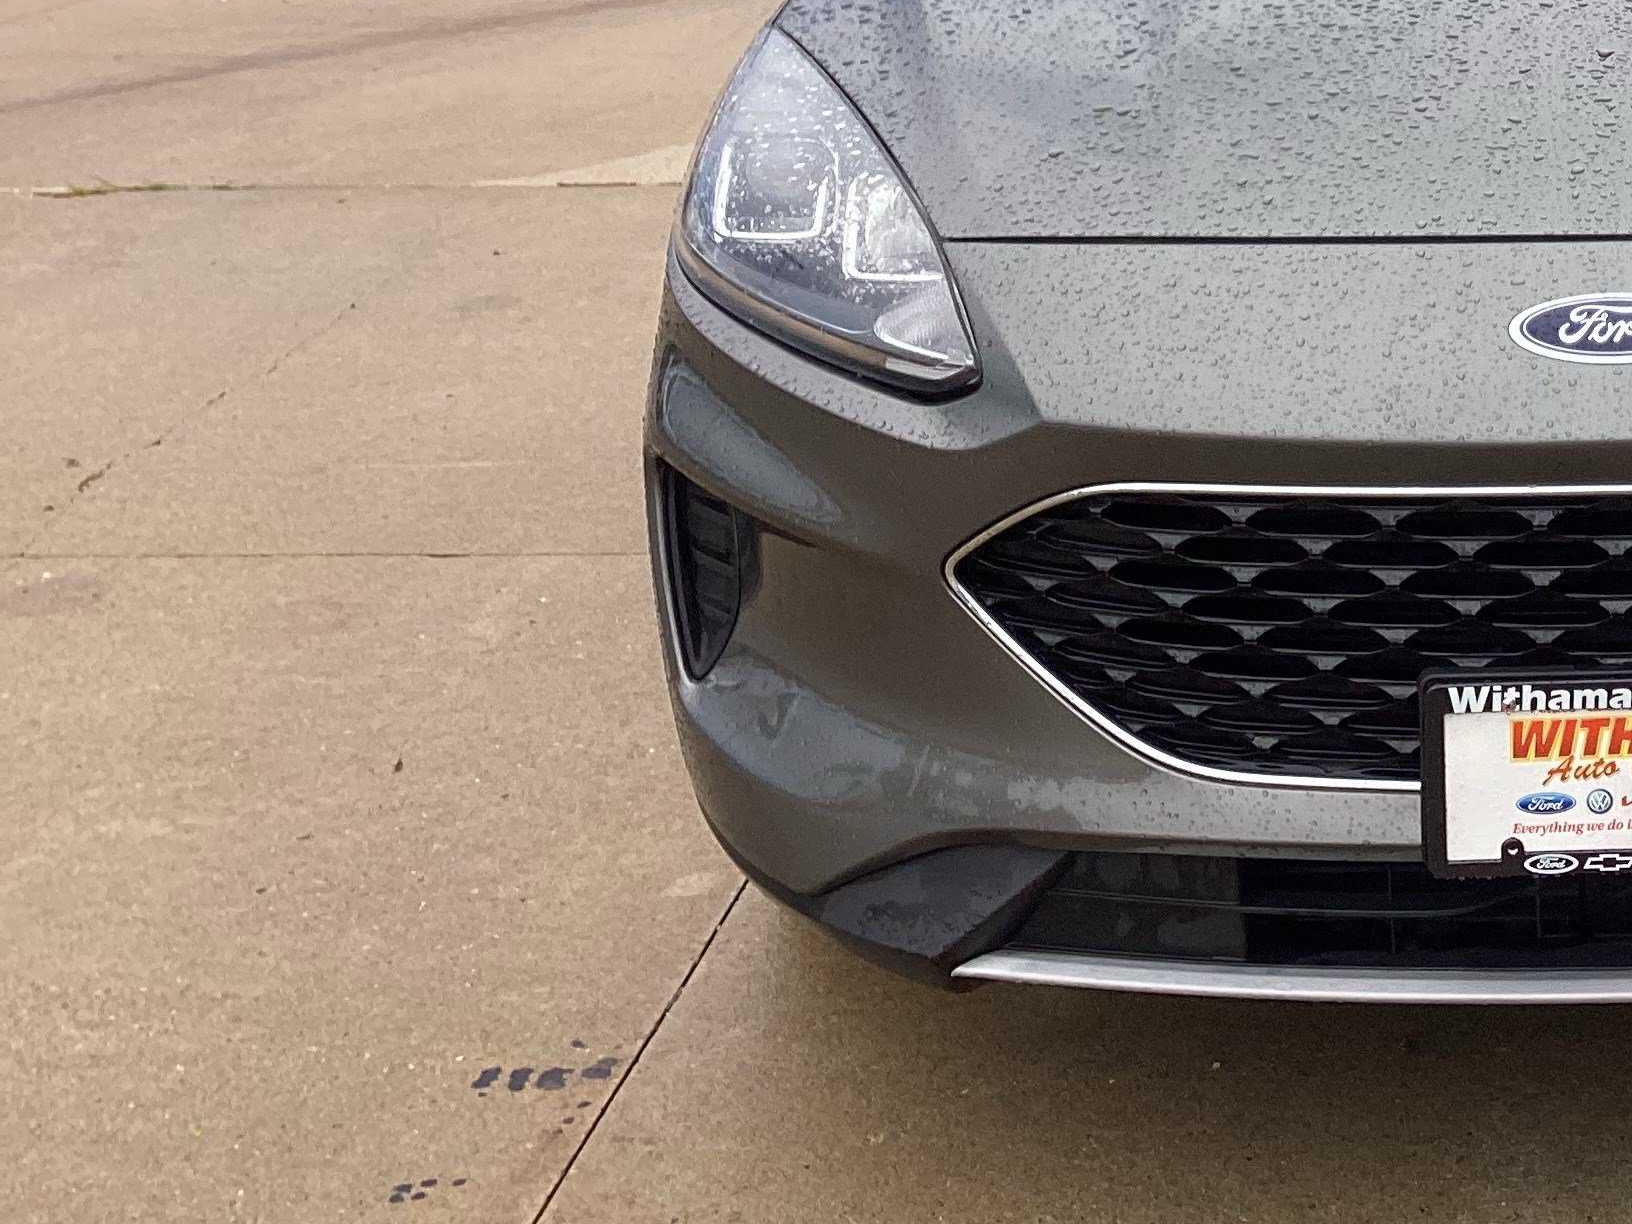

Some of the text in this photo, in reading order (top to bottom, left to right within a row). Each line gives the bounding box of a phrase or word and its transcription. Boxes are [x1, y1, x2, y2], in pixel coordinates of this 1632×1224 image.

[1542, 755, 1620, 786] Auto
[1528, 795, 1564, 811] Ford
[1513, 821, 1584, 836] Everything
[1587, 822, 1604, 831] we
[1607, 819, 1624, 831] do
[1536, 857, 1566, 869] Ford
